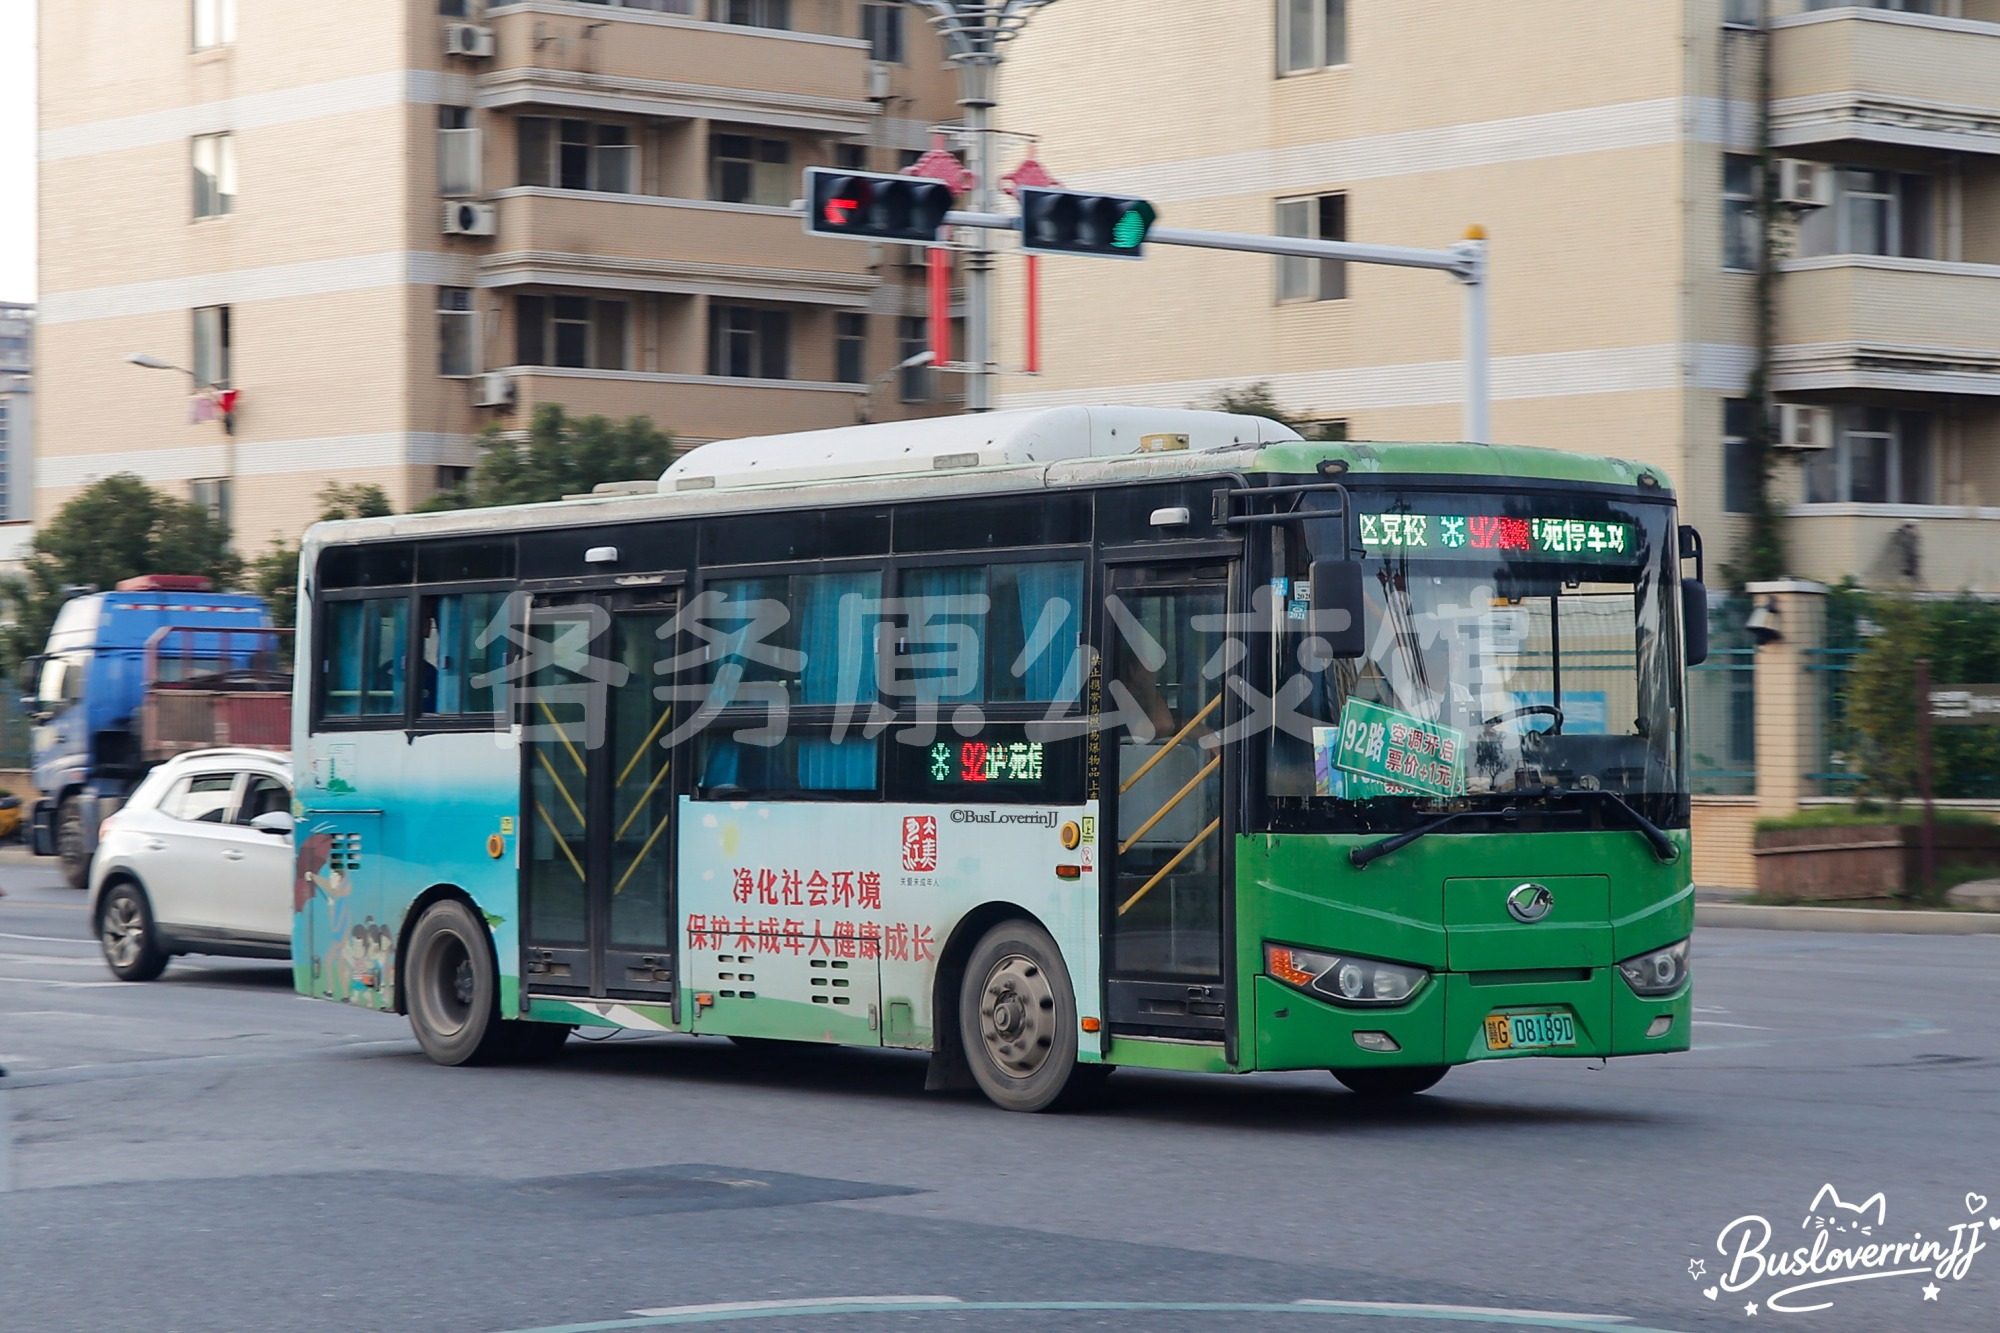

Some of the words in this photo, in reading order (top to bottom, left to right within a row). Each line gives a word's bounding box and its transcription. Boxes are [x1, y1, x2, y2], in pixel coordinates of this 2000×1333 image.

[1344, 718, 1385, 763] 92路
[1390, 723, 1456, 764] 空调开启
[1385, 748, 1453, 788] 票价+1元
[733, 867, 881, 909] 净化社会环境
[686, 913, 936, 962] 保护未成年人健康成长
